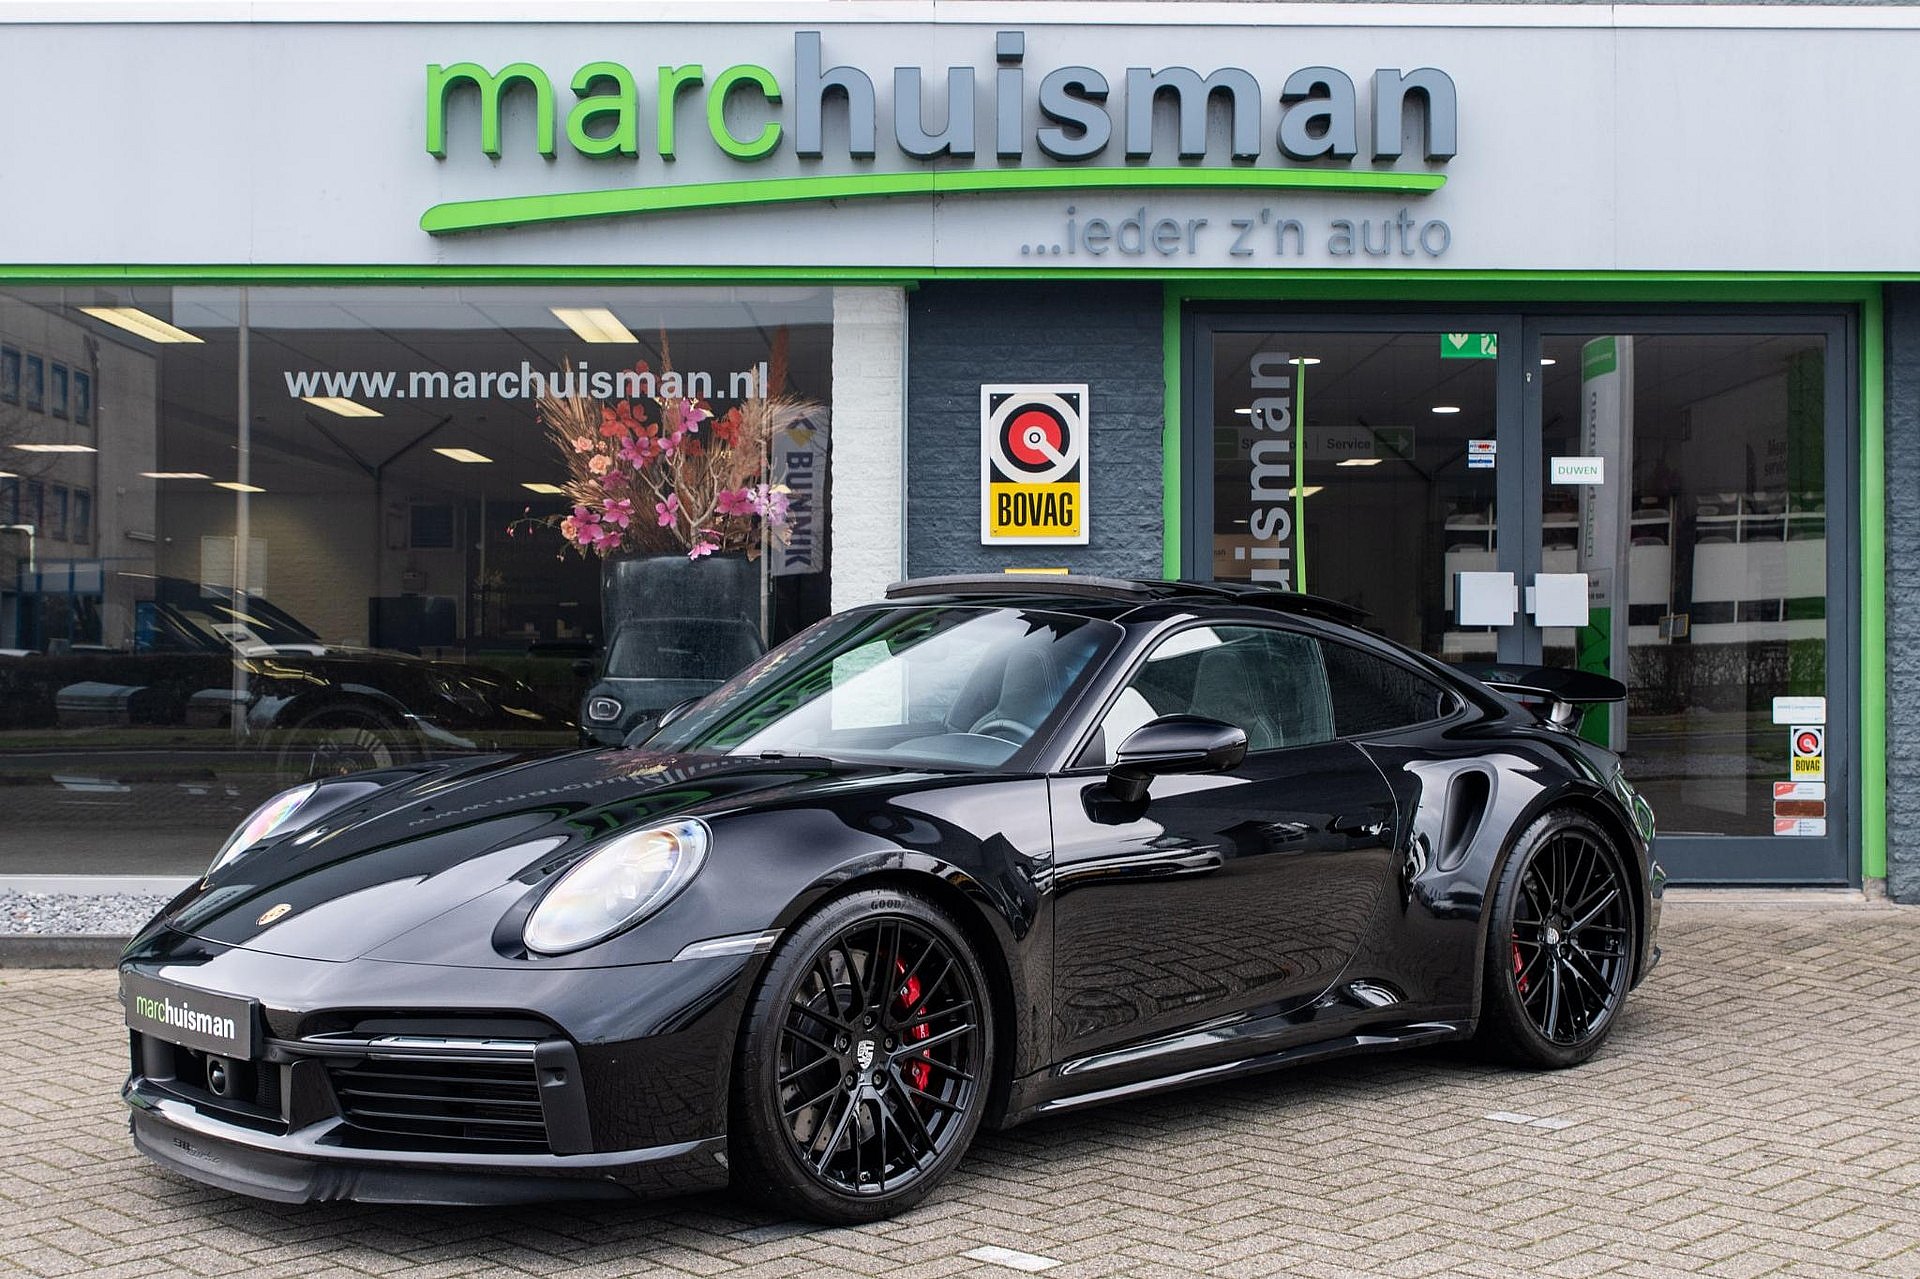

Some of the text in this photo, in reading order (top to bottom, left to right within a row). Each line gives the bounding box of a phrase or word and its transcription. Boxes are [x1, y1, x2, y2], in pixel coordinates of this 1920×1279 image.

[425, 30, 1457, 162] marchuisman
[1229, 207, 1304, 256] z'n
[1326, 208, 1452, 257] auto
[284, 361, 769, 400] www.marchuisman.nl
[1558, 465, 1598, 475] DUWEN
[785, 451, 813, 568] BUNNIK
[998, 492, 1073, 527] BOVAG
[1795, 759, 1820, 772] BOVAG
[136, 996, 235, 1040] marchuisman
